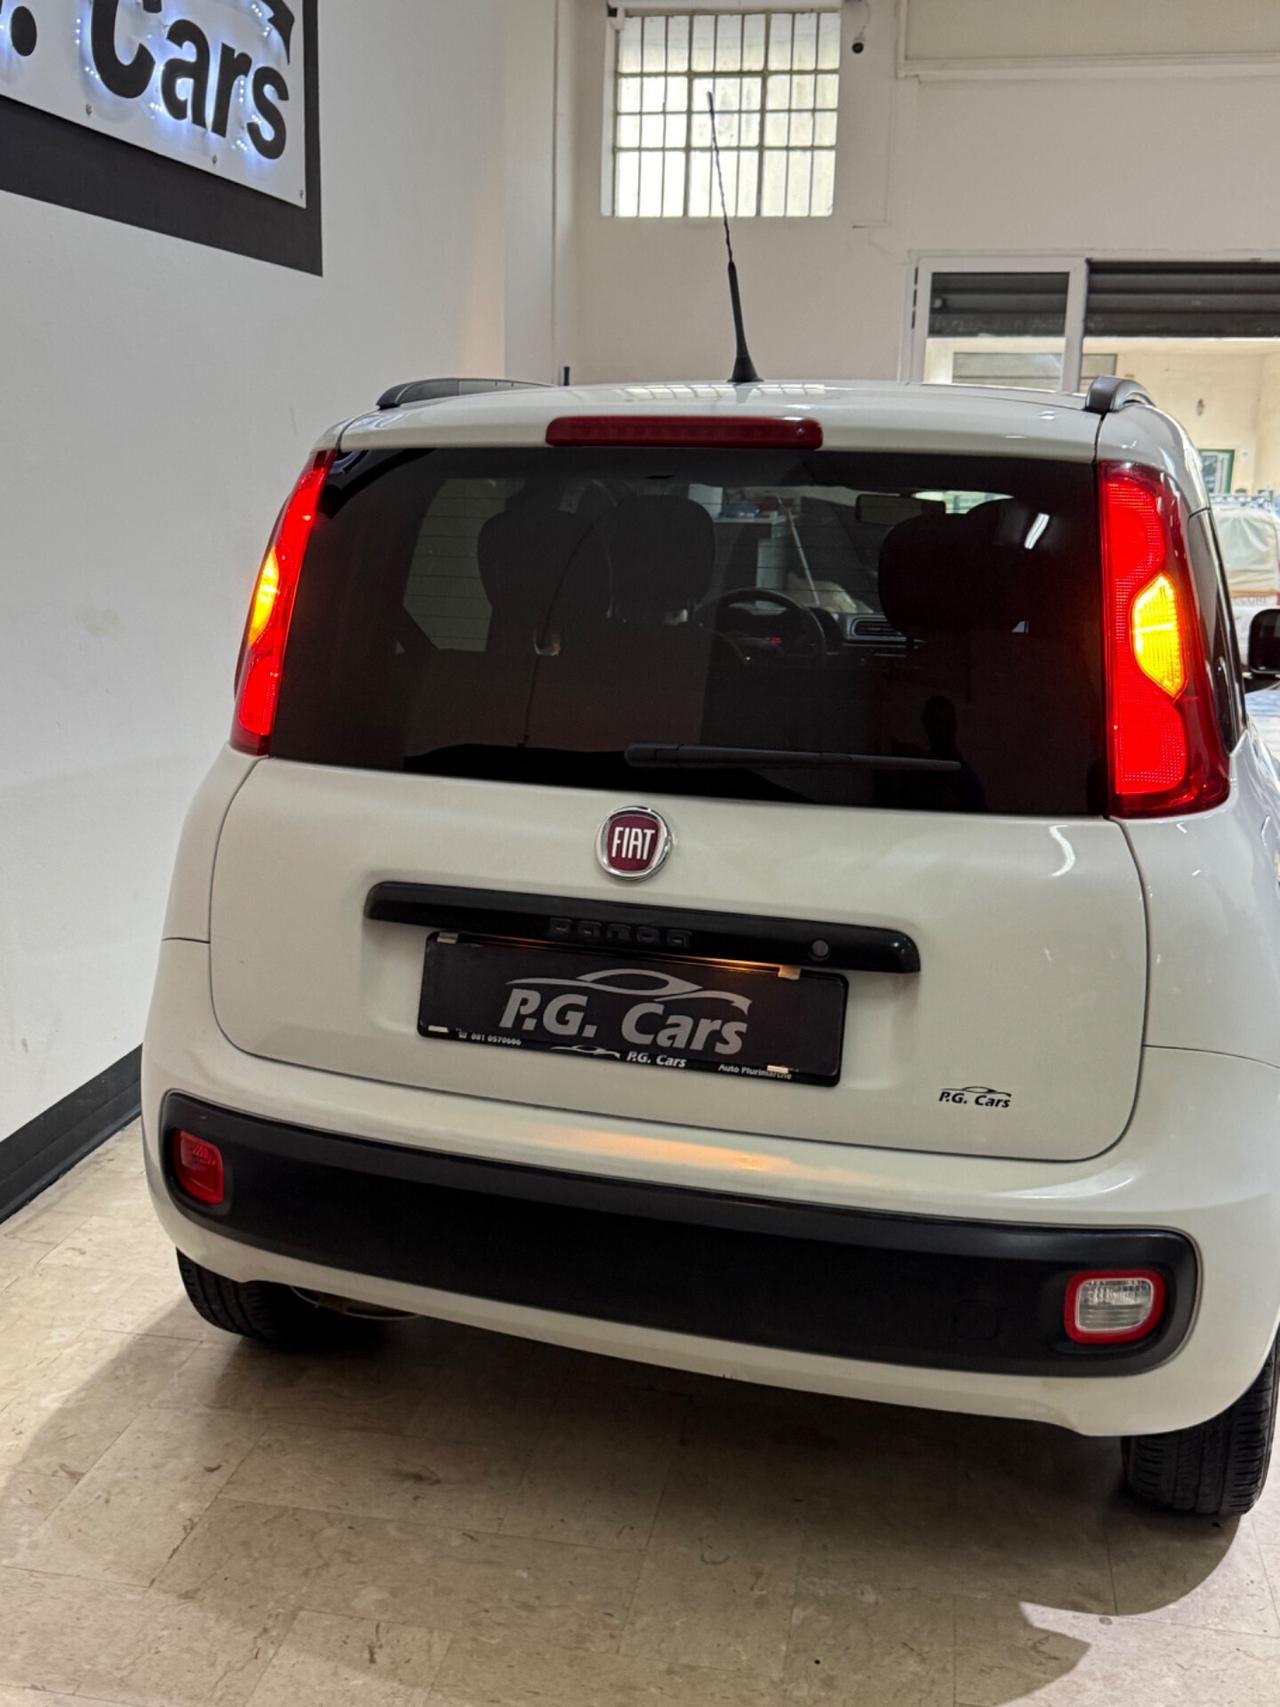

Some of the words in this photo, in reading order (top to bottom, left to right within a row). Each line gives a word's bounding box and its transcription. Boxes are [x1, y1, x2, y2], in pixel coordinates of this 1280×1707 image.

[91, 0, 290, 160] Cars
[612, 827, 655, 860] FIAT
[499, 988, 597, 1038] P.G.
[621, 1002, 748, 1054] Cars
[626, 1051, 651, 1064] P.G.
[656, 1055, 687, 1068] Cars
[718, 1063, 740, 1073] Auto
[938, 1091, 968, 1105] P.G.
[974, 1094, 1011, 1109] Cars
